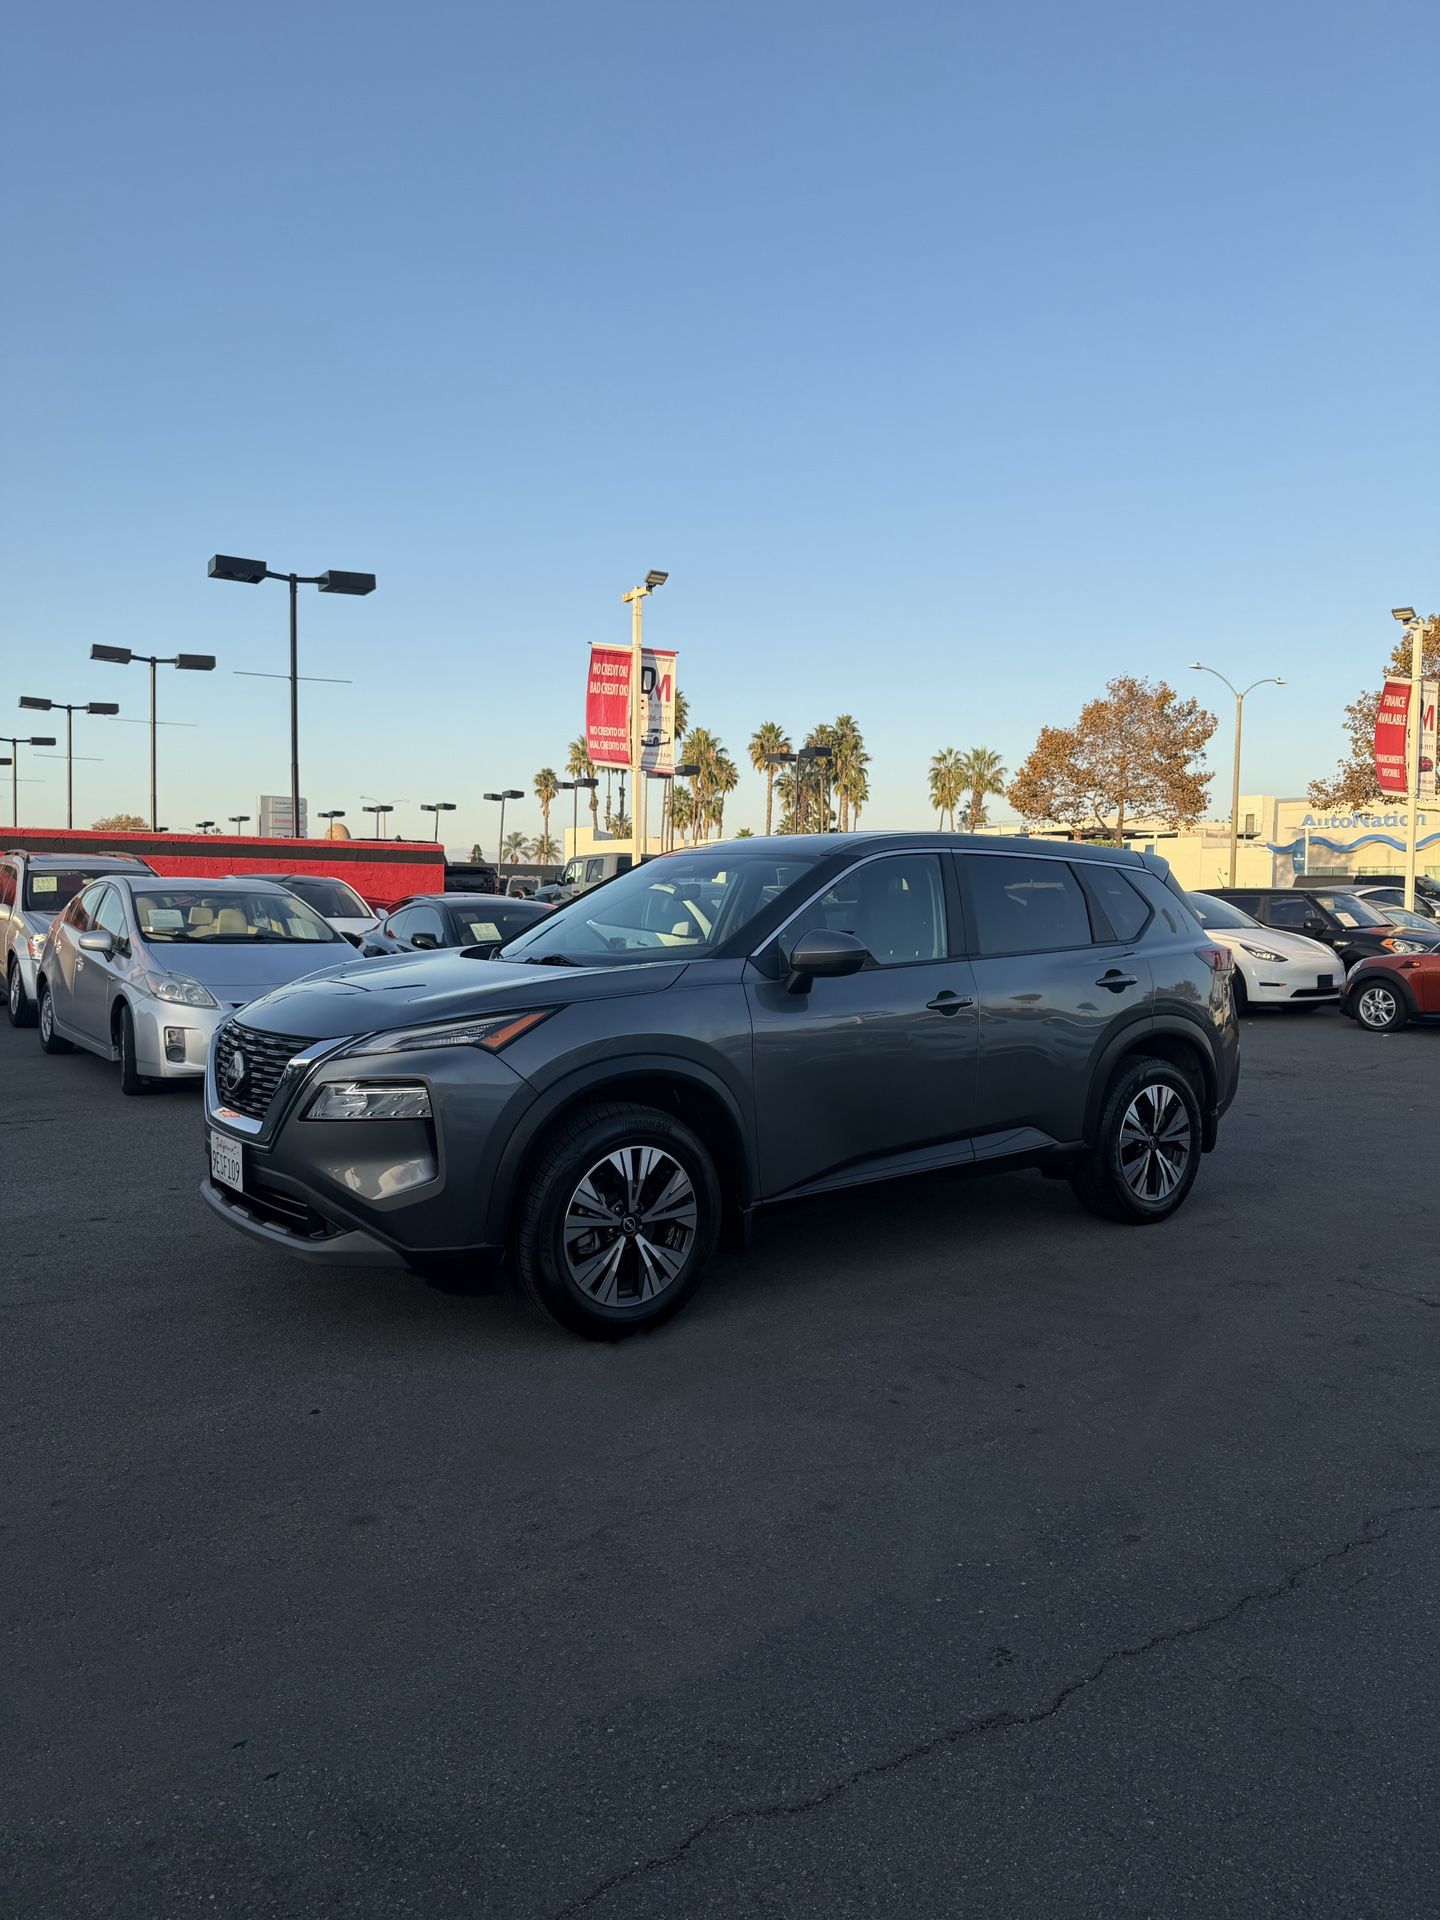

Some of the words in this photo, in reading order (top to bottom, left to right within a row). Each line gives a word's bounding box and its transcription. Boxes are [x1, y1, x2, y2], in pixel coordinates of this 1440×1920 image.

[593, 662, 601, 675] NO
[601, 663, 619, 676] CREDIT
[619, 665, 629, 677] OK!
[590, 681, 600, 694] BAD
[601, 682, 619, 695] CREDIT
[619, 684, 629, 697] OK!
[1383, 694, 1406, 708] FINANCE
[1378, 712, 1407, 726] AVAILABLE
[589, 725, 597, 735] NO
[598, 726, 617, 737] CREDITO
[589, 740, 600, 750] MAL
[600, 740, 619, 751] CREDITO
[1301, 810, 1427, 829] AutoNation
[213, 1150, 240, 1185] 9ESF109
